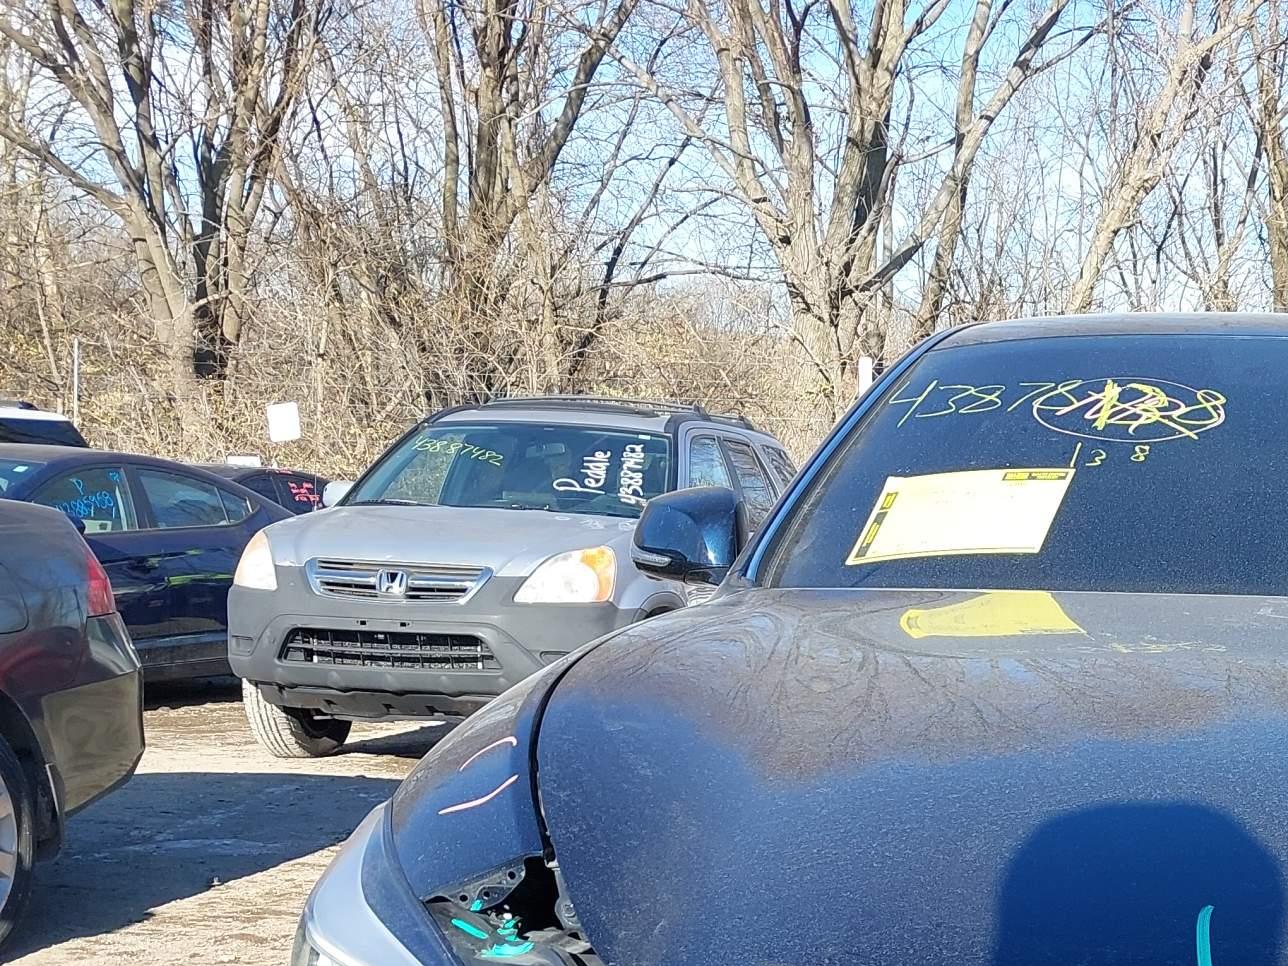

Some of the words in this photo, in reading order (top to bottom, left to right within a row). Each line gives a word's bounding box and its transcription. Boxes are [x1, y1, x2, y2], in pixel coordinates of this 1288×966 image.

[413, 435, 504, 466] 43887482
[552, 449, 612, 494] Peddle
[617, 443, 645, 505] 43887482
